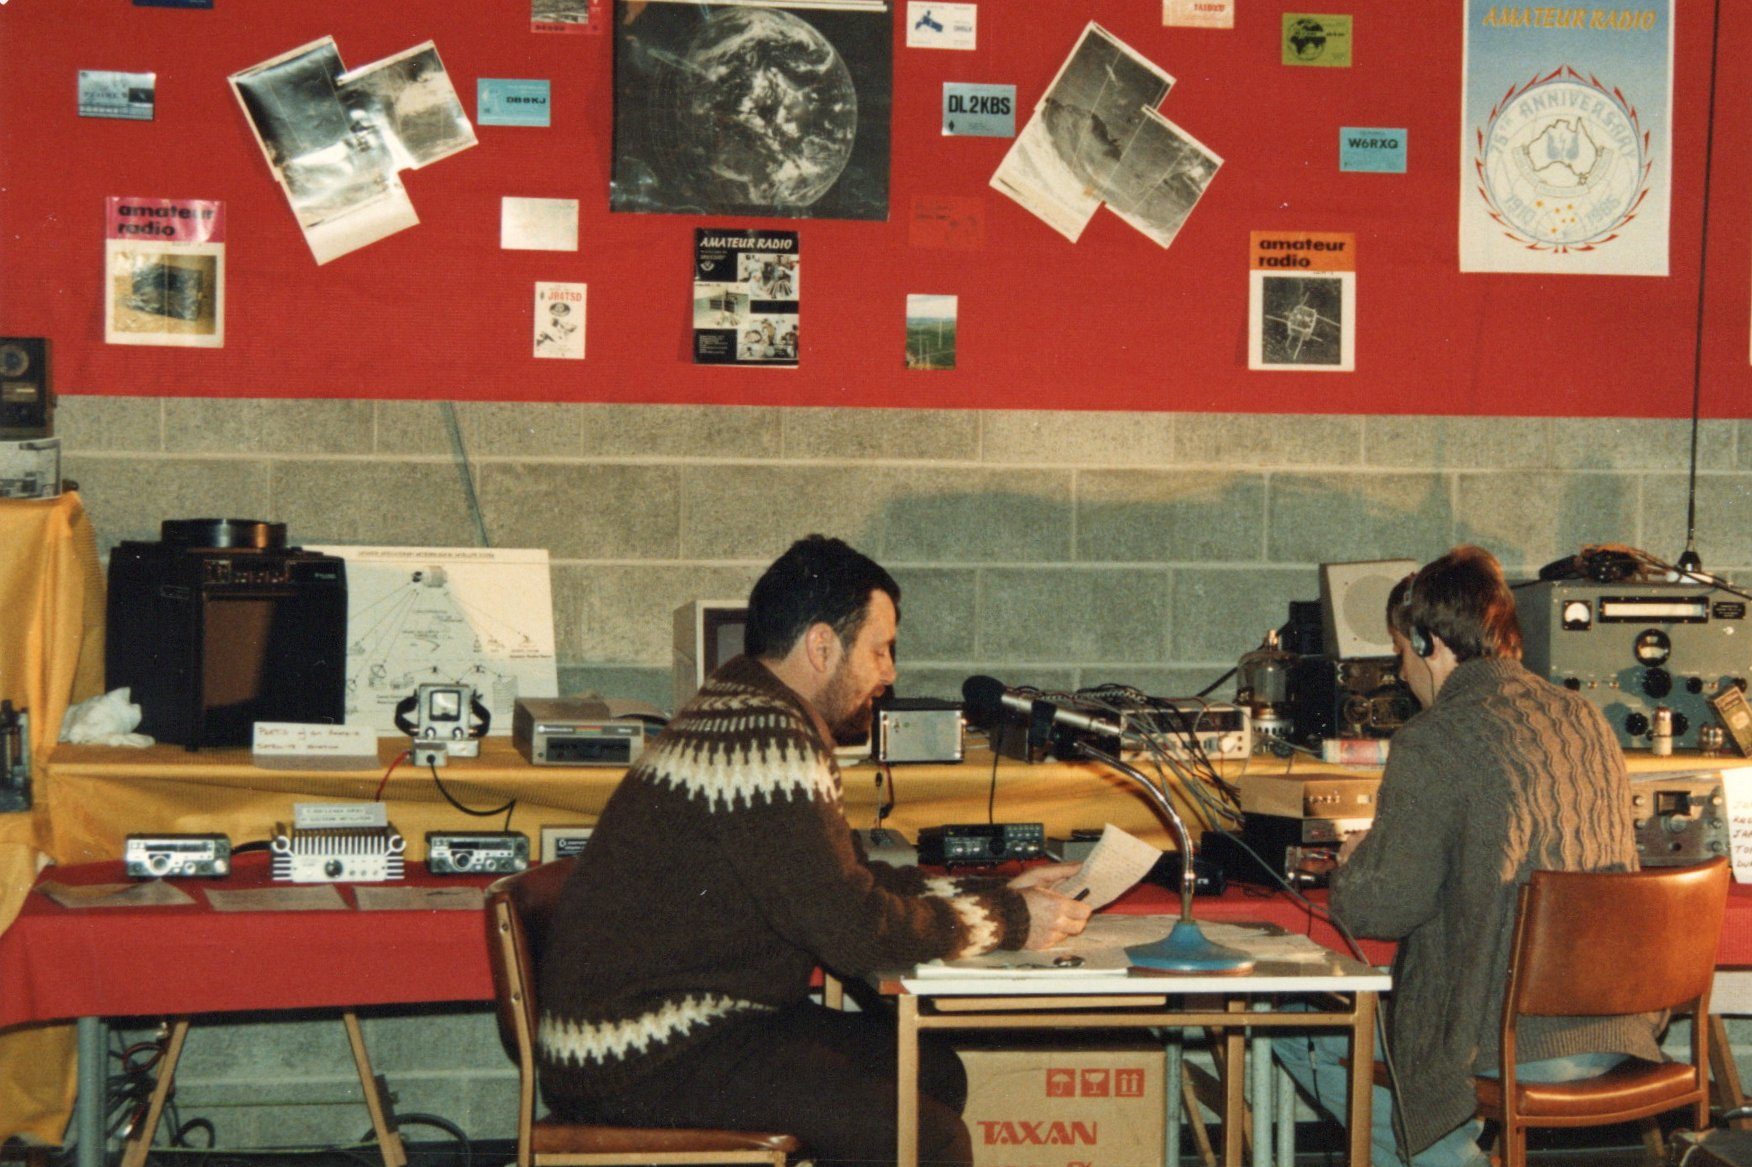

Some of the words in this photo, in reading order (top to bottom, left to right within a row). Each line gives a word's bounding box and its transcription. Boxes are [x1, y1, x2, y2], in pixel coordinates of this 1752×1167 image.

[1482, 6, 1587, 28] AMATEUR
[1589, 9, 1657, 31] RADIO
[948, 94, 1011, 115] DL2KBS
[1348, 137, 1399, 149] W6RXQ
[118, 221, 175, 236] radio
[700, 237, 755, 249] AMATEUR
[756, 239, 793, 250] RADIO
[1259, 239, 1345, 251] amateur
[1259, 254, 1311, 267] radio
[976, 1121, 1098, 1146] TAXAN
